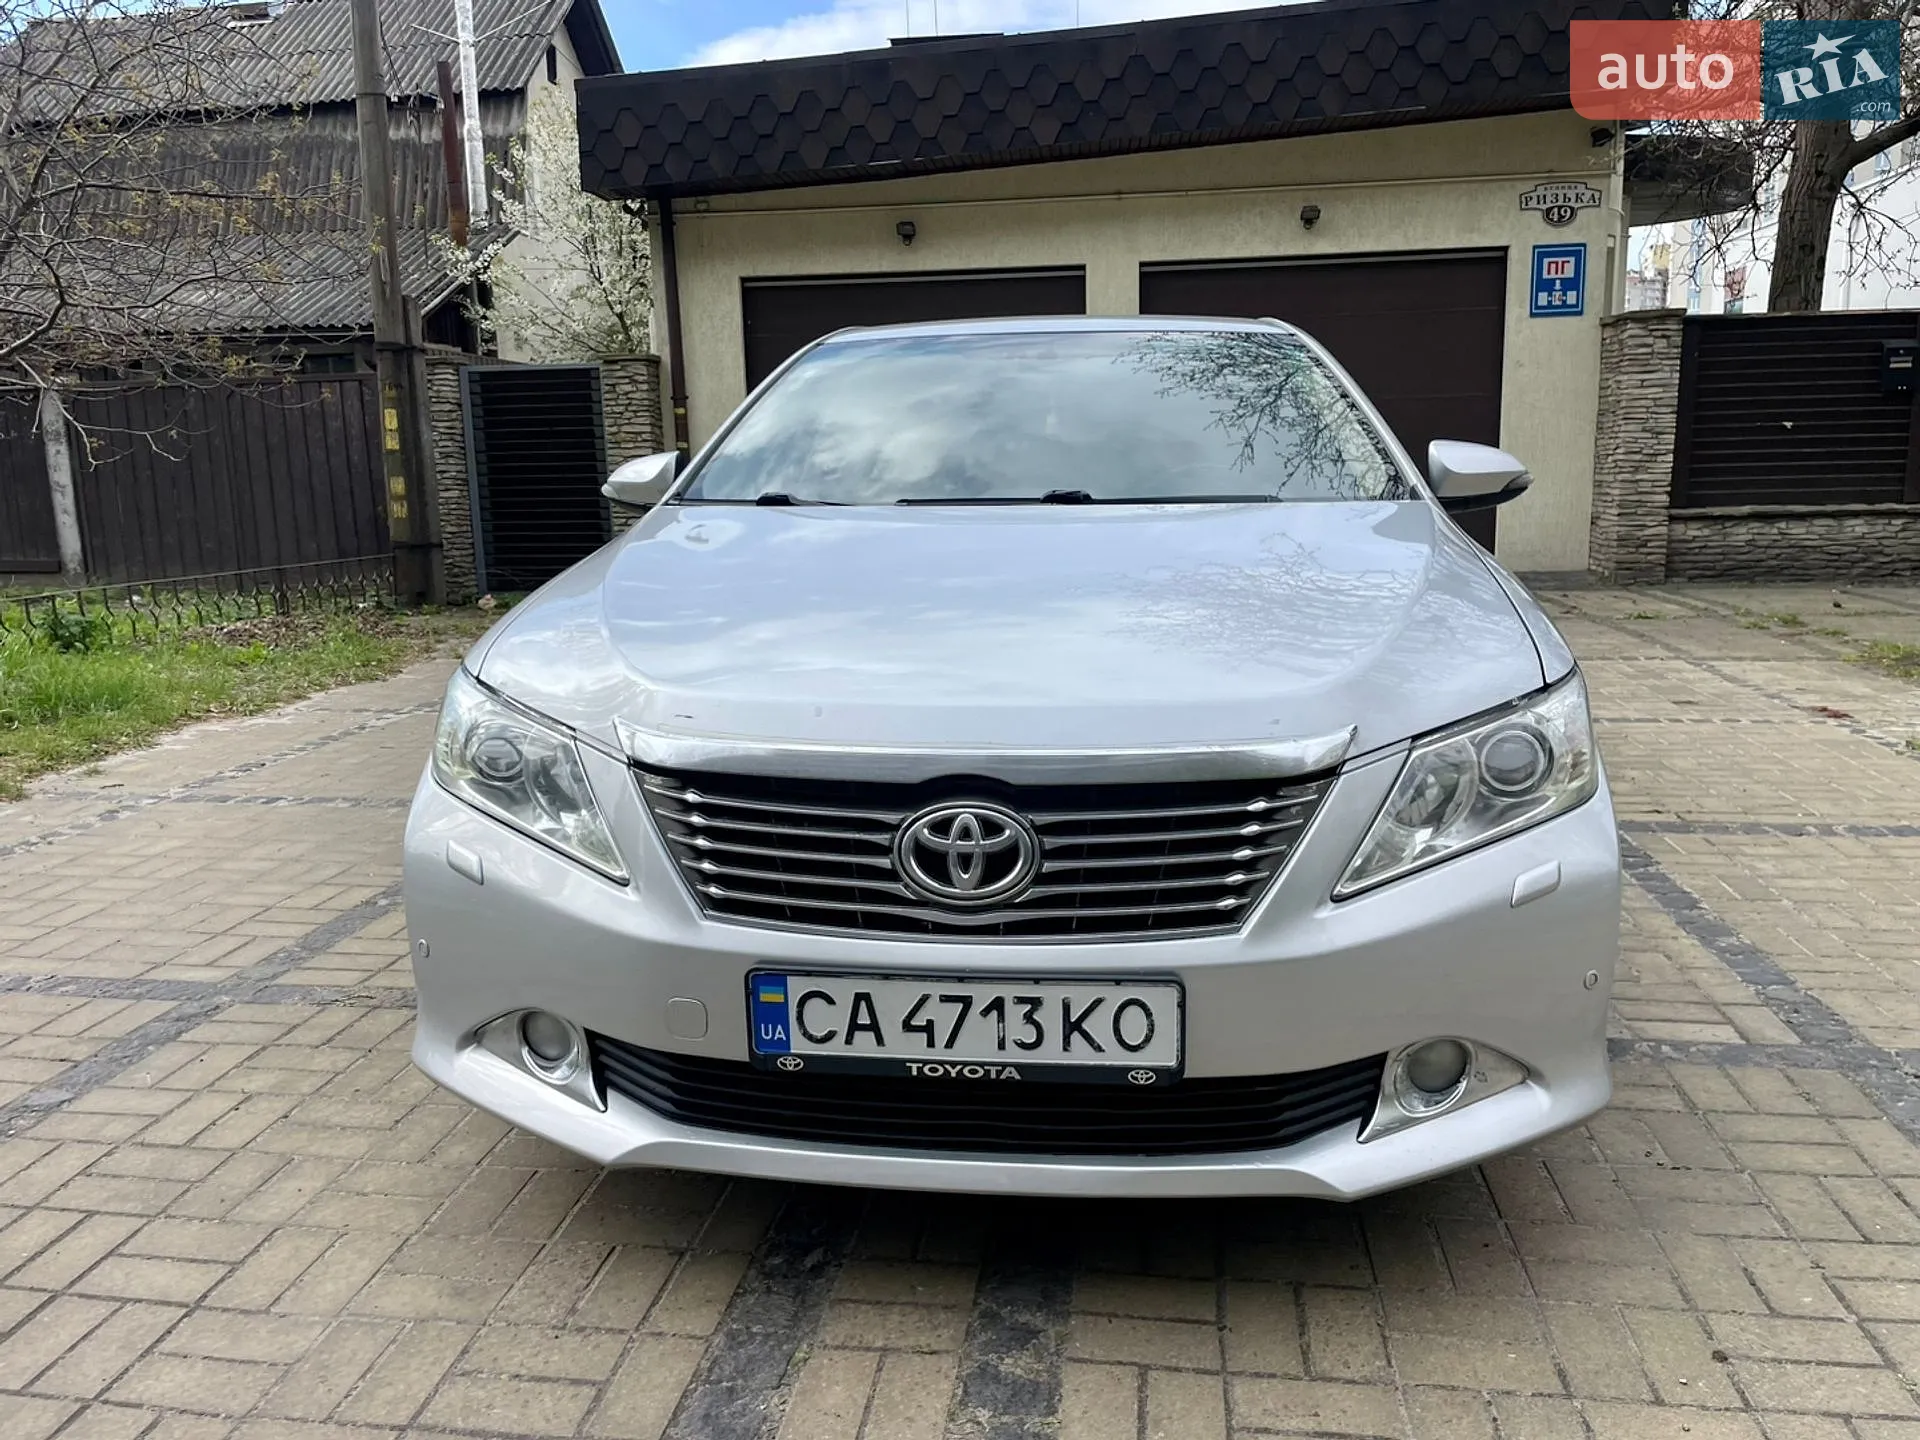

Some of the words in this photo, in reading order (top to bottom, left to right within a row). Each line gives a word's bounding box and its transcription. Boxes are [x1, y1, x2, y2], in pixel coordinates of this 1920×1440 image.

[1524, 192, 1597, 207] РИЗЬКА
[1549, 206, 1571, 221] 49
[1547, 260, 1570, 275] ПГ
[796, 990, 886, 1046] CA
[902, 993, 1045, 1052] 4713
[1061, 996, 1155, 1053] KO
[761, 1024, 786, 1041] UA
[906, 1062, 1022, 1081] TOYOTA
